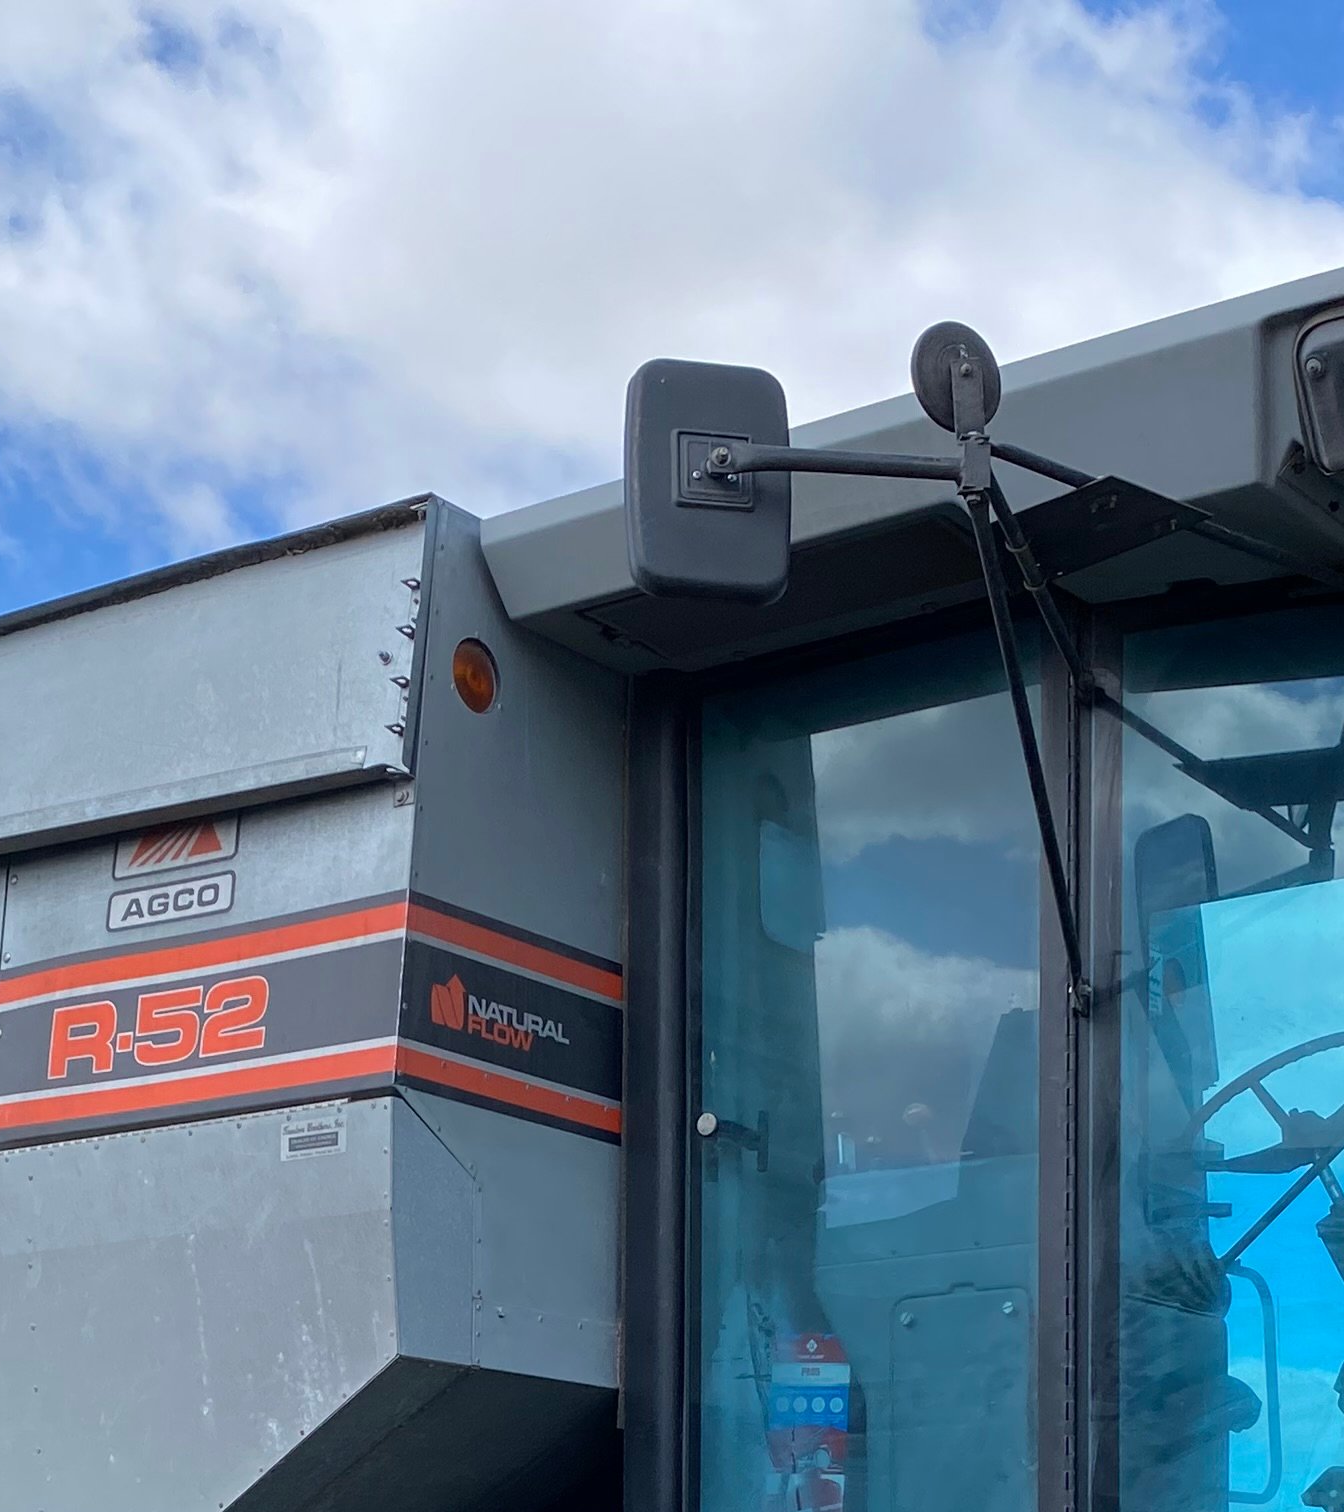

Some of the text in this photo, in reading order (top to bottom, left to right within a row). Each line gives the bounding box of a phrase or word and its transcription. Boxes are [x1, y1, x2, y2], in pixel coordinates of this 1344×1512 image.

[121, 883, 219, 921] AGCO
[47, 975, 269, 1080] R-52
[467, 1015, 534, 1051] FLOW
[468, 994, 570, 1045] NATURAL
